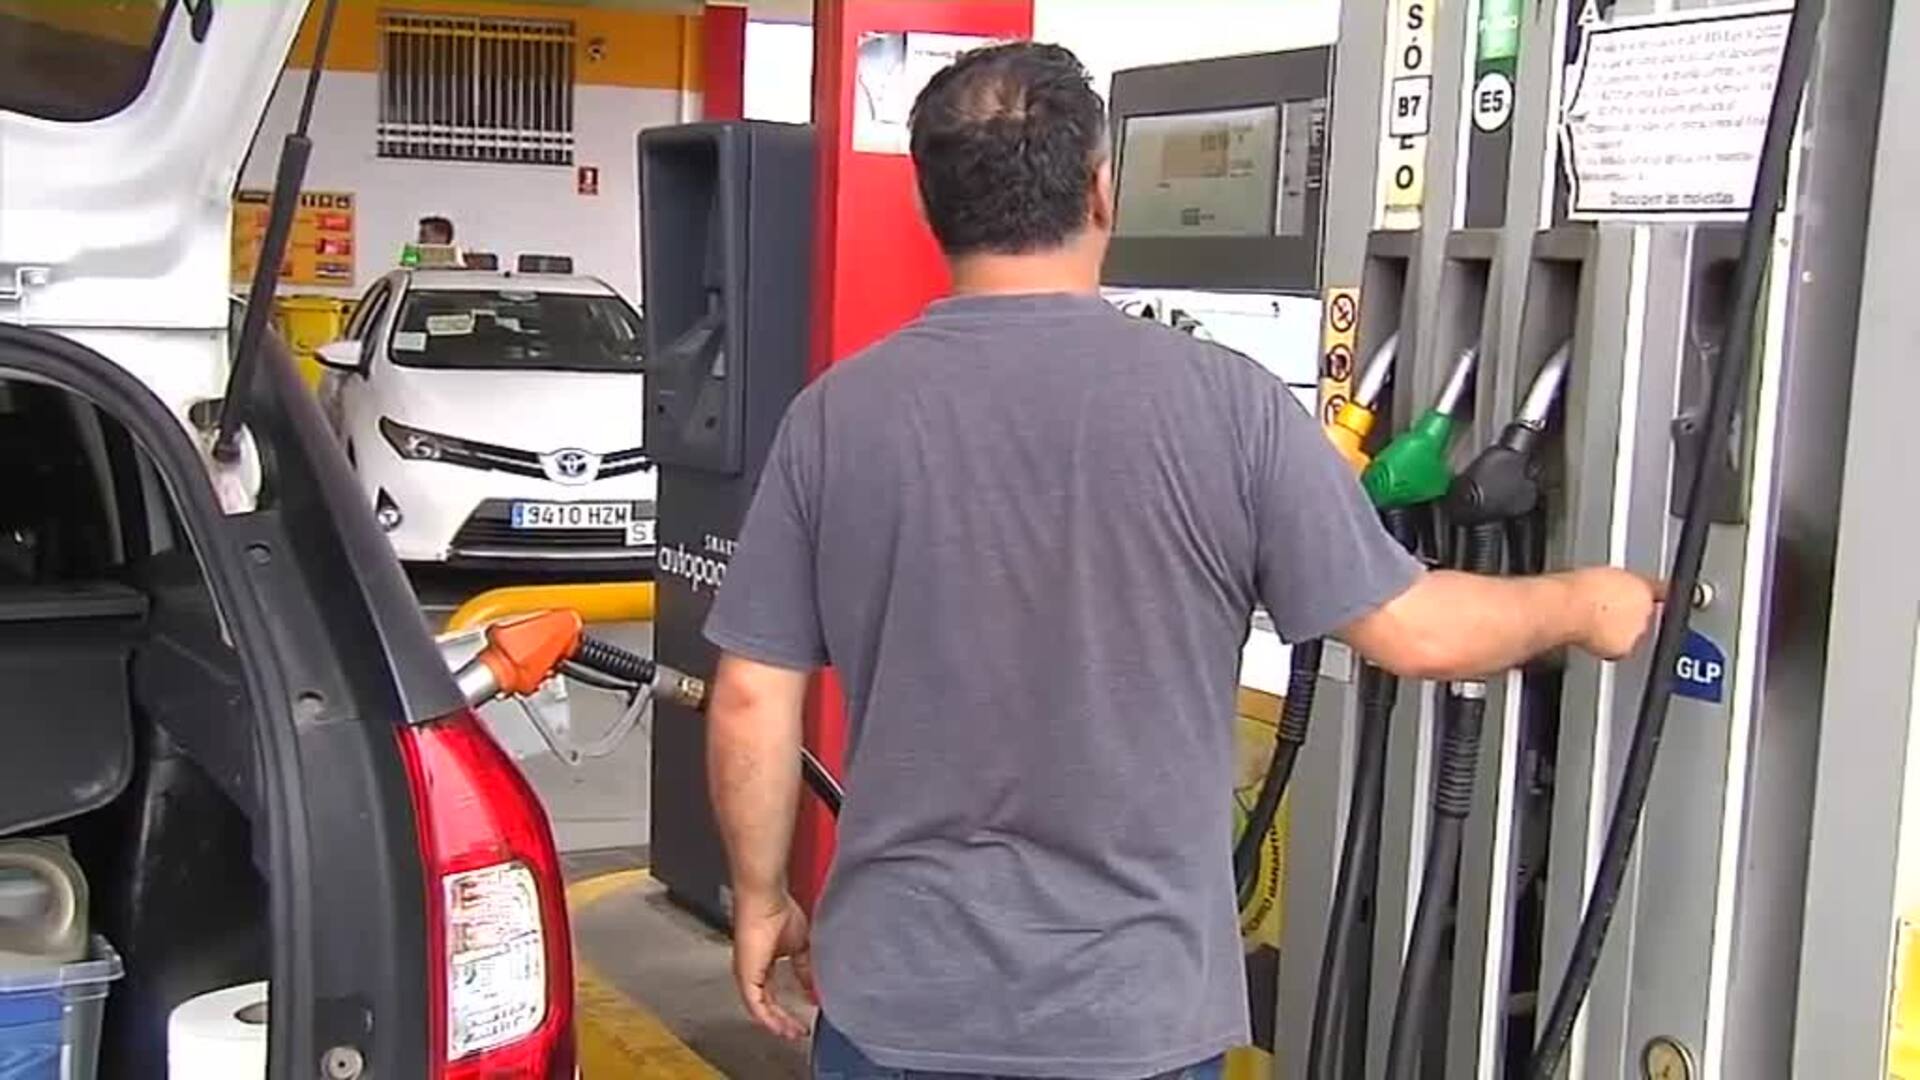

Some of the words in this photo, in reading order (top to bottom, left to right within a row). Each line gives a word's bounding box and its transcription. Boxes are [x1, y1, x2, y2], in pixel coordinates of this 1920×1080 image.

[1397, 95, 1422, 117] B7
[1479, 89, 1505, 113] E5
[528, 505, 581, 525] 9410
[1676, 655, 1722, 684] GLP
